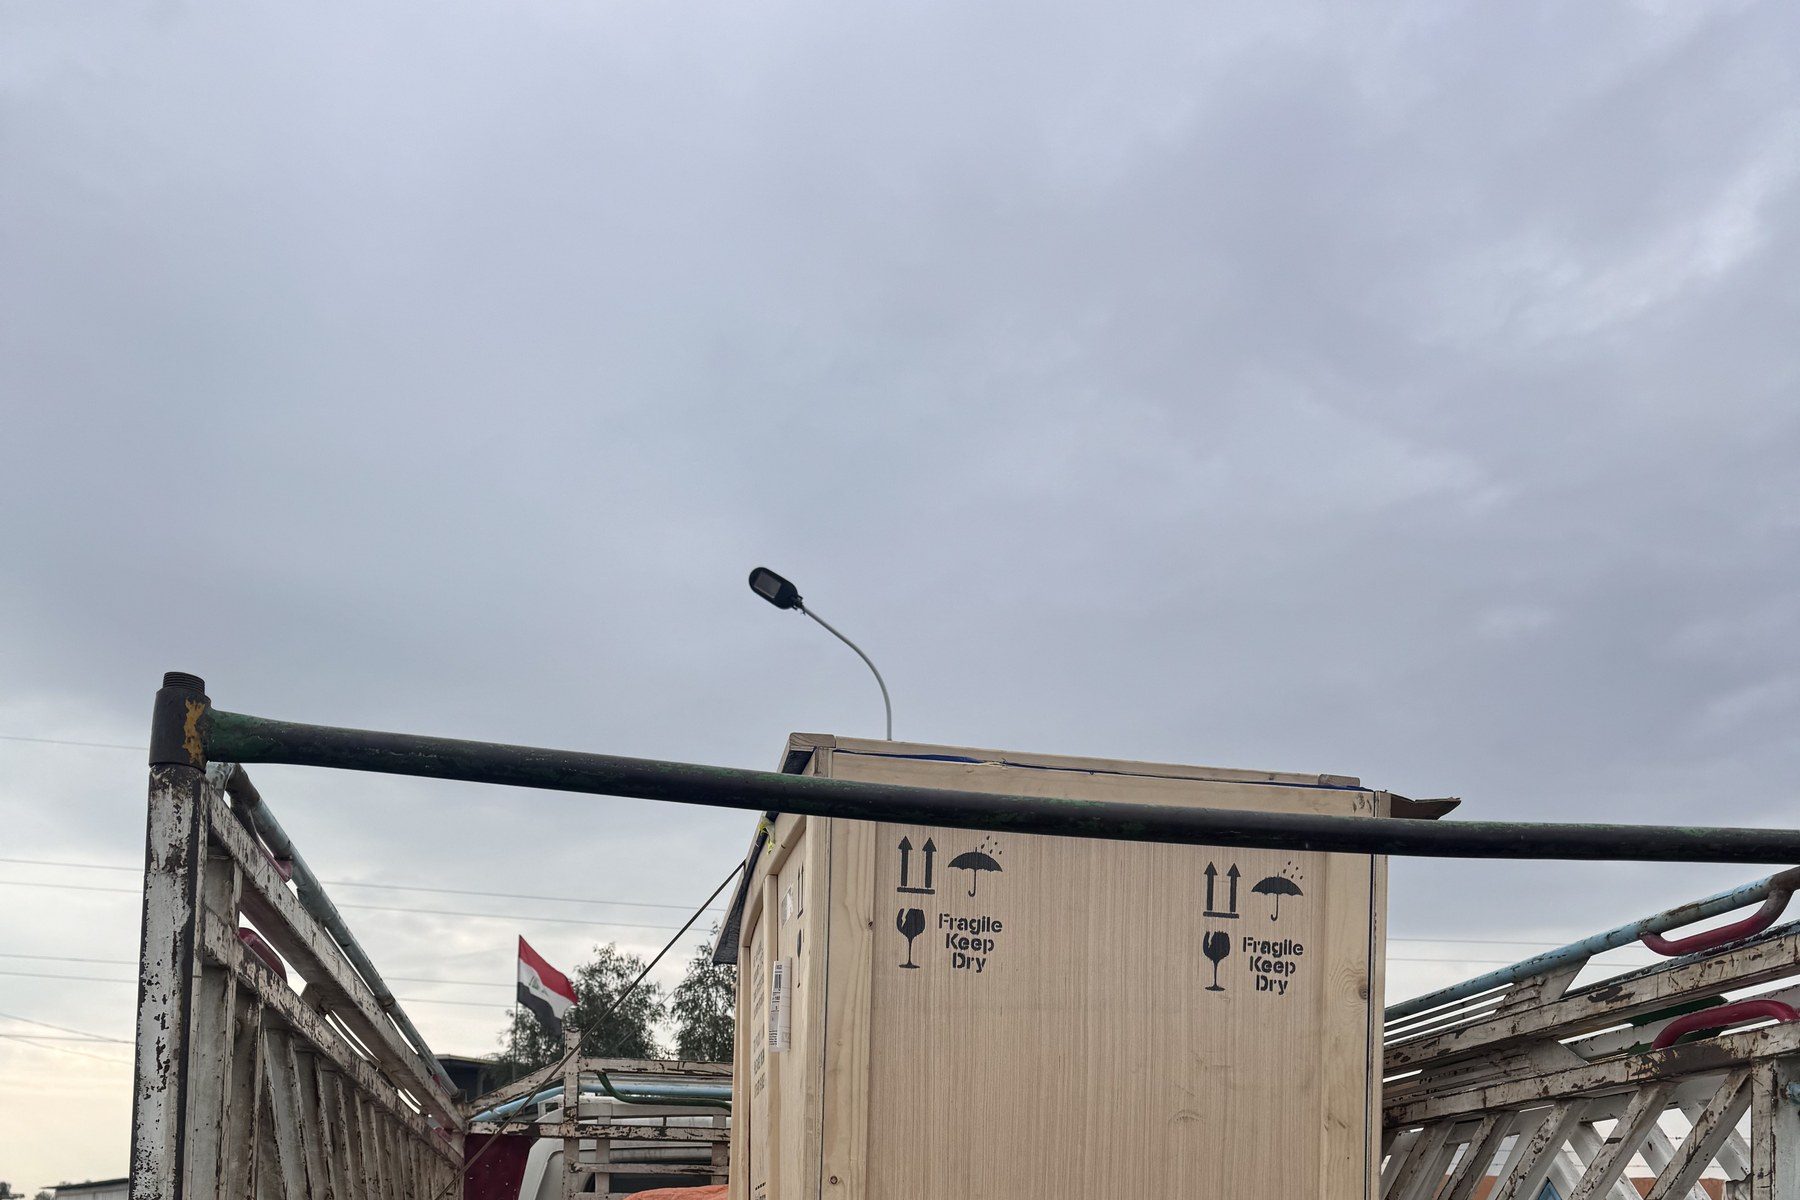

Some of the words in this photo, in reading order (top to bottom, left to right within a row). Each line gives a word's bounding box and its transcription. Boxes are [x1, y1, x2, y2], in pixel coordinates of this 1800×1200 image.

[939, 913, 1002, 937] Fragile
[946, 932, 994, 954] Keep
[1243, 937, 1303, 960] Fragile
[953, 952, 986, 973] Dry
[1250, 955, 1295, 976] Keep
[1256, 975, 1288, 995] Dry
